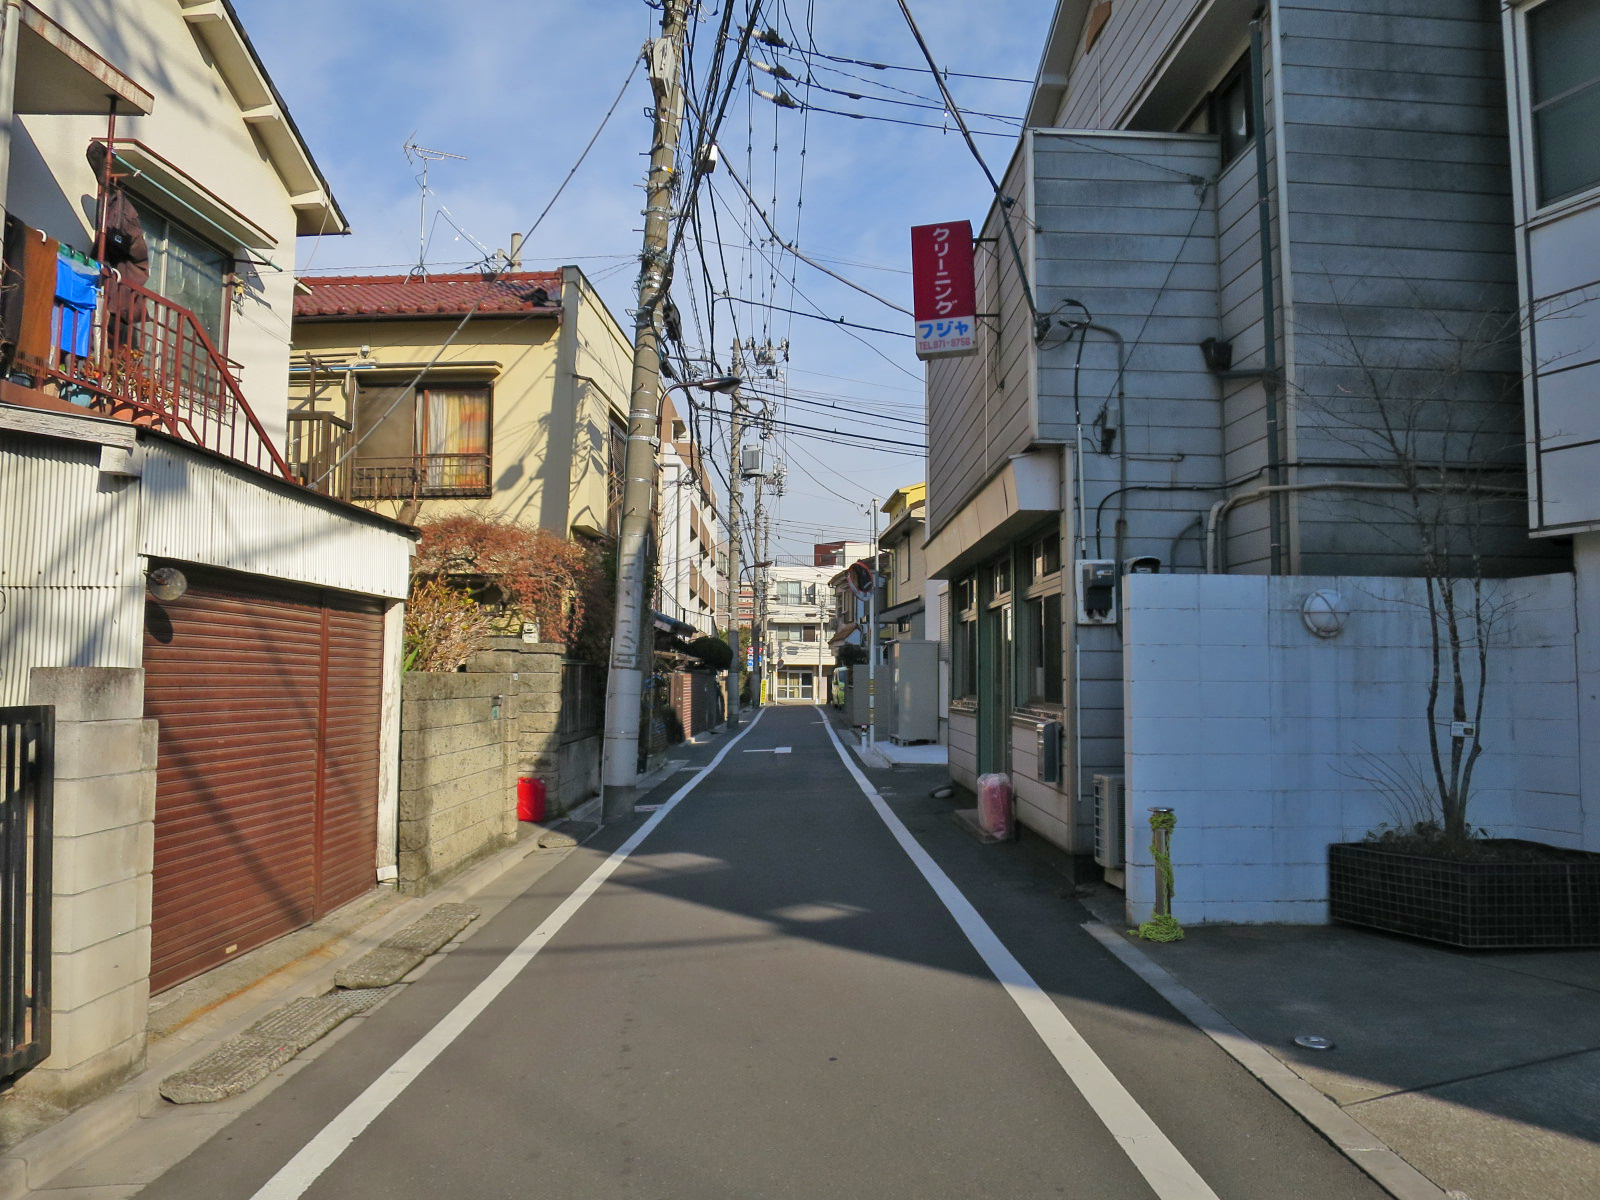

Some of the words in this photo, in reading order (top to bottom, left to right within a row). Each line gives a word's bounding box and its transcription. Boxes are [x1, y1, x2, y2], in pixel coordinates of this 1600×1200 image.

[933, 227, 958, 315] クリーニング
